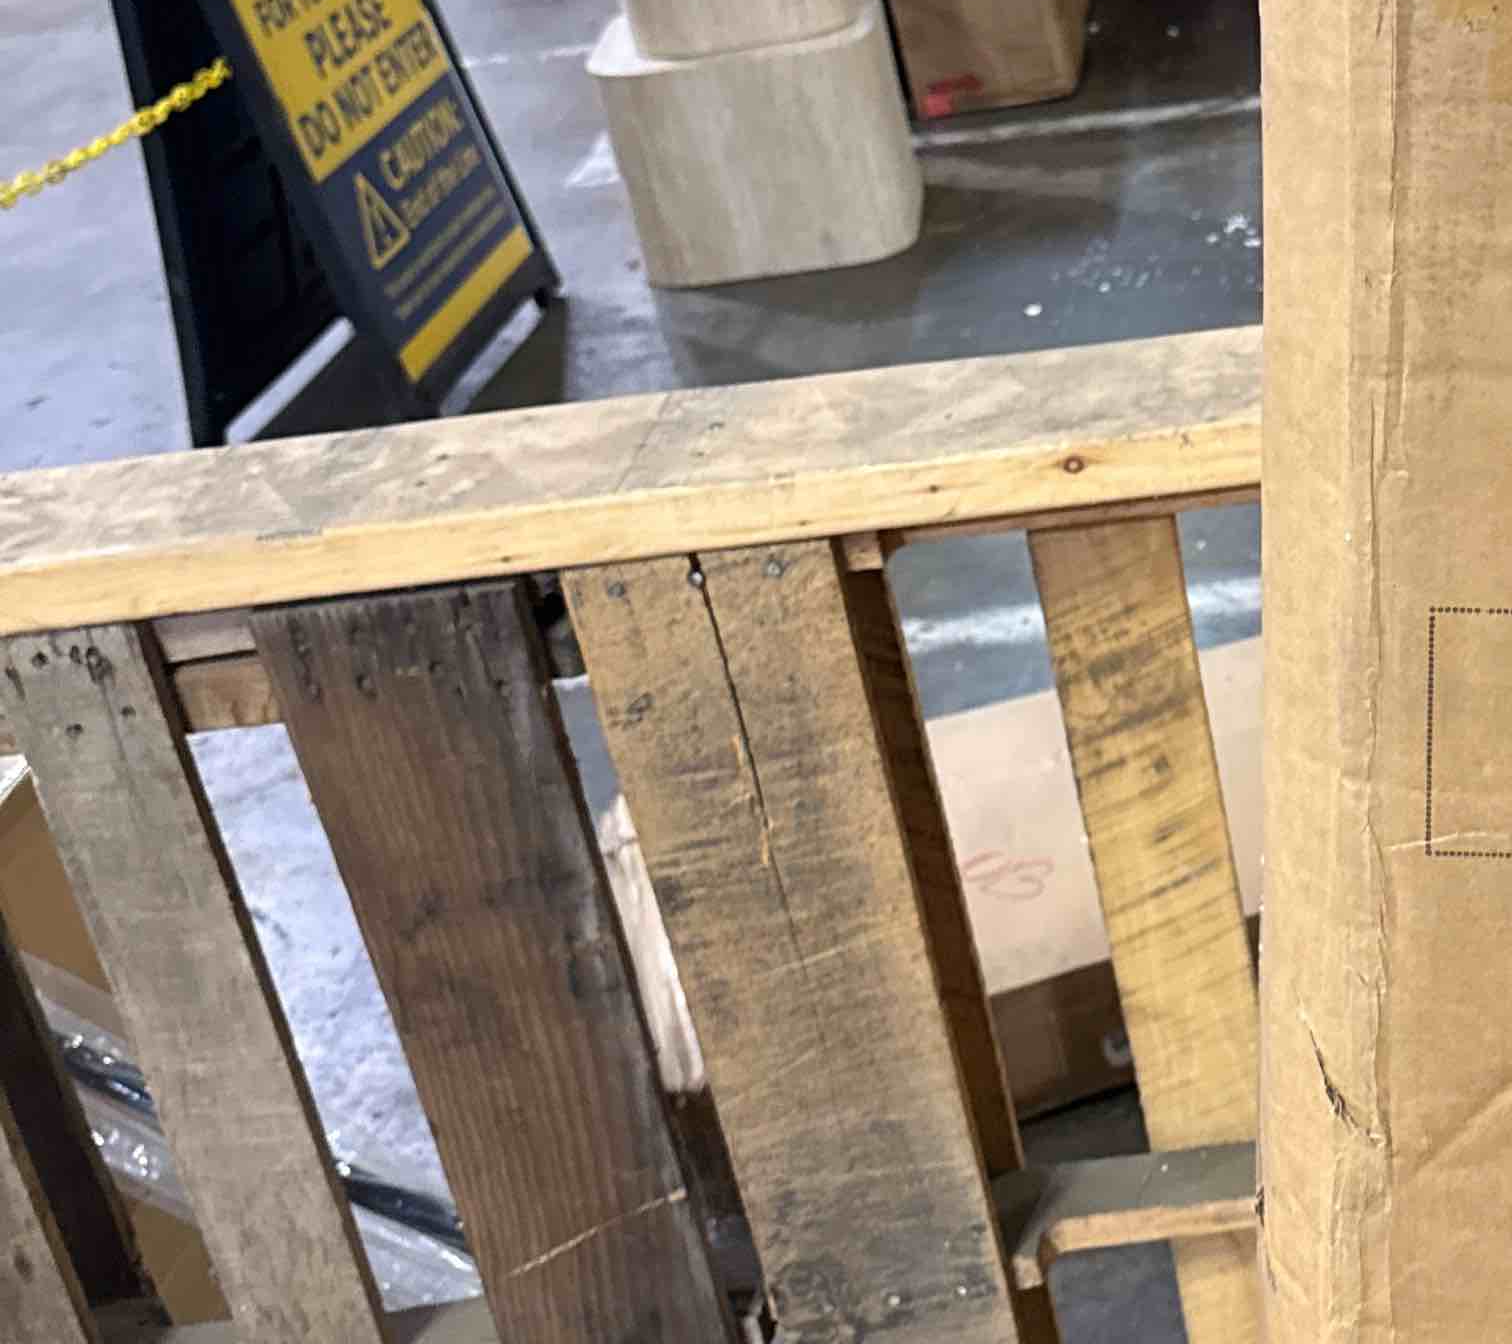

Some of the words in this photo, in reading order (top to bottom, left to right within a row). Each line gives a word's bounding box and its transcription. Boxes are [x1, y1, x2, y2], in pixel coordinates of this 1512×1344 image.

[298, 100, 342, 160] DO
[332, 64, 384, 130] NOT
[374, 20, 440, 96] ENTER
